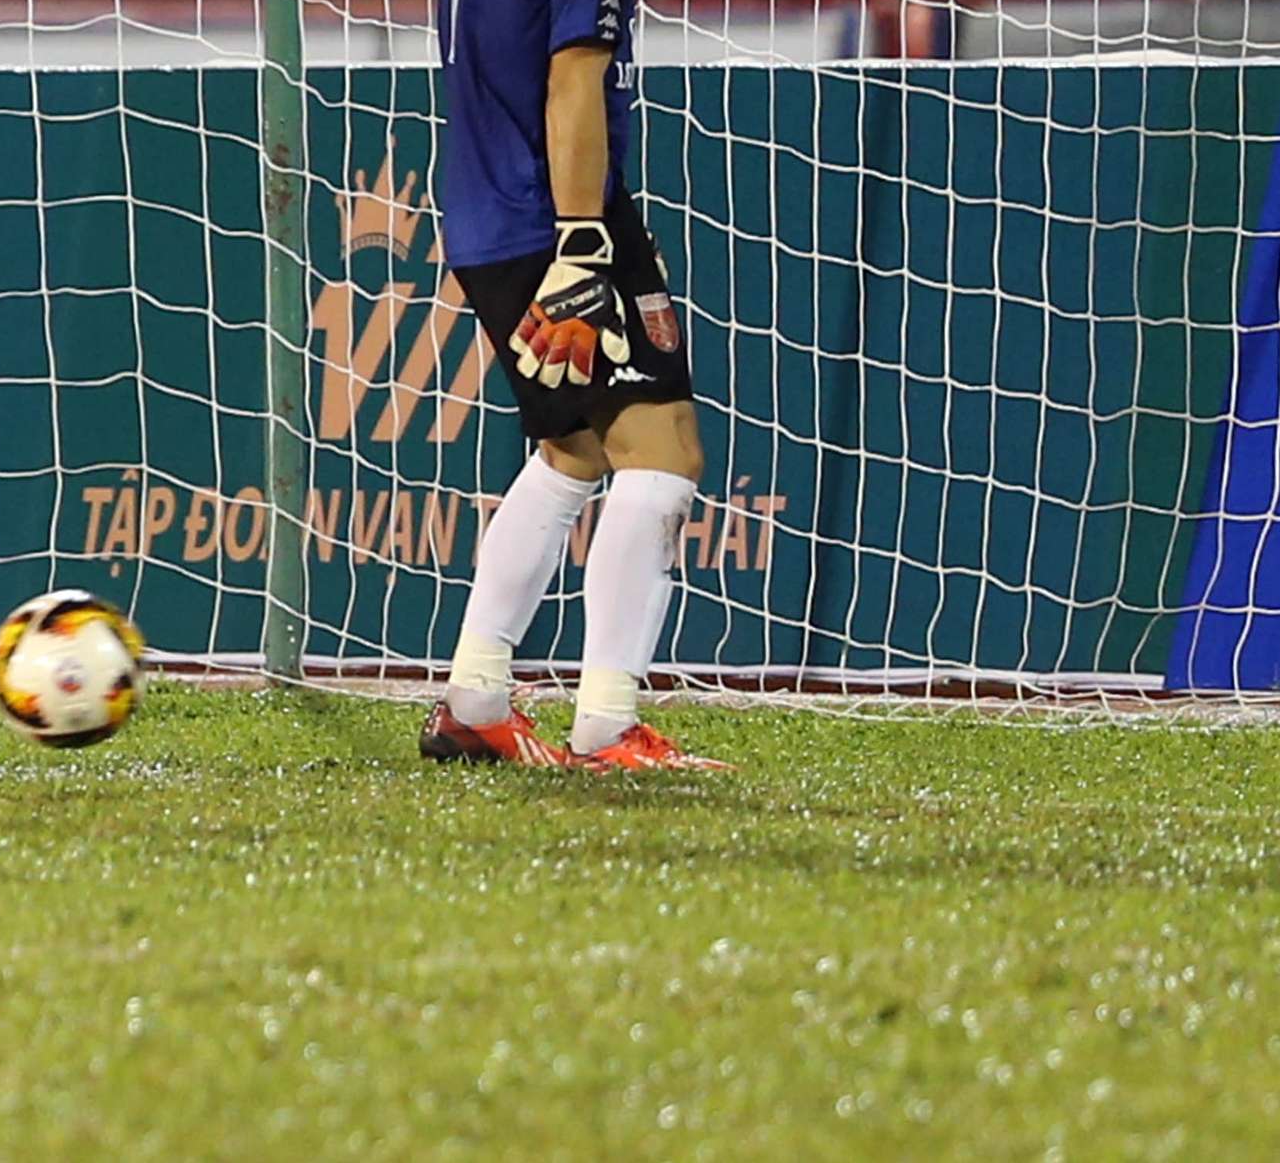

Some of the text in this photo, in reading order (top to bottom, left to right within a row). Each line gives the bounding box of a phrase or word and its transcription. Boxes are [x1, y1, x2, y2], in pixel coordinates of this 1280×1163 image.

[82, 468, 177, 578] TẬP
[184, 487, 342, 563] ĐON
[675, 476, 787, 571] HÁT
